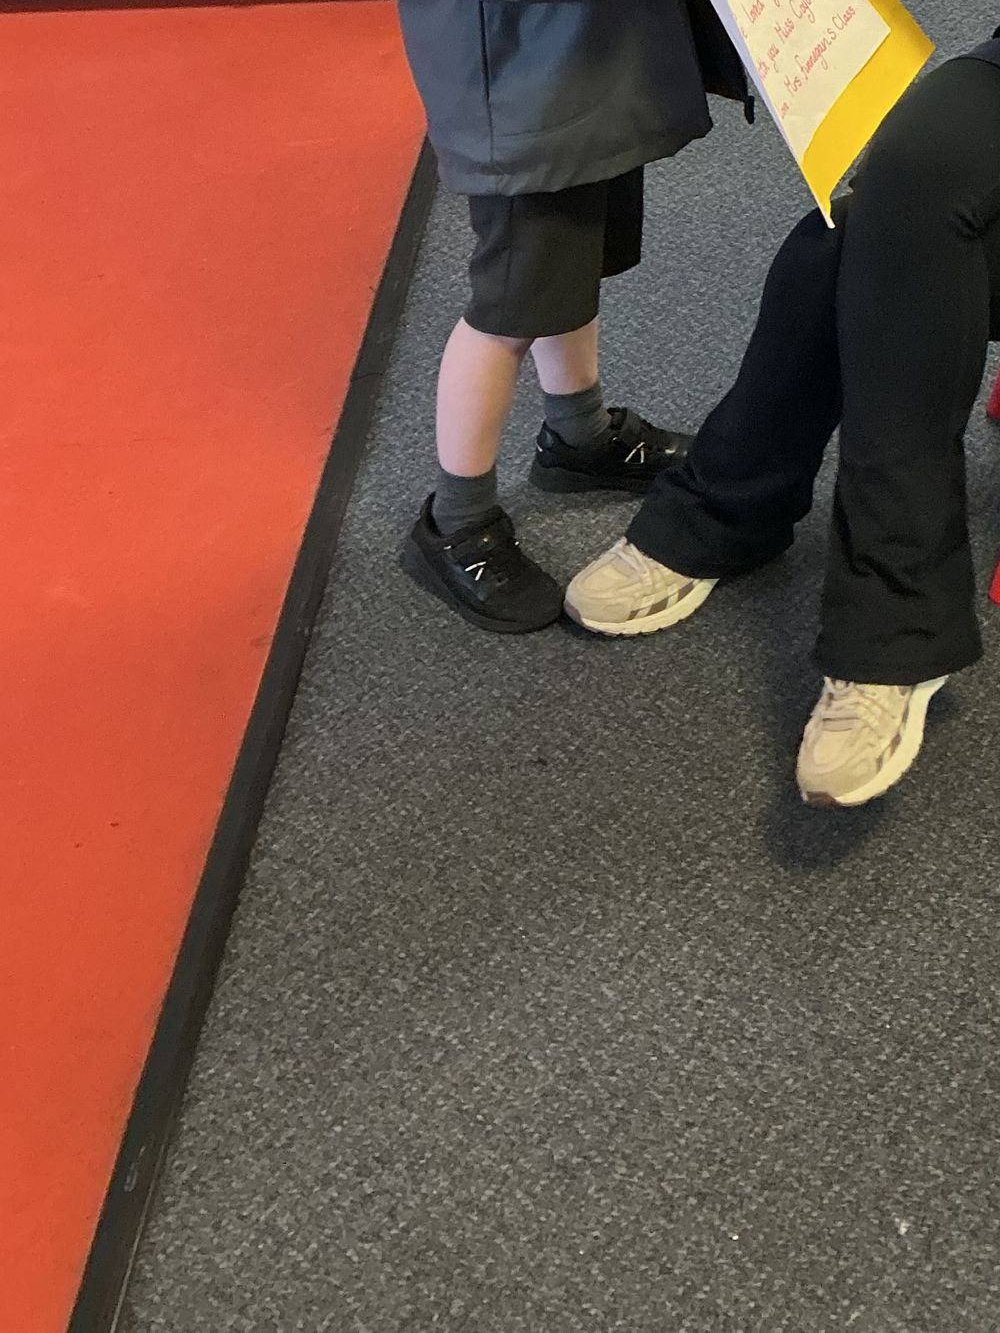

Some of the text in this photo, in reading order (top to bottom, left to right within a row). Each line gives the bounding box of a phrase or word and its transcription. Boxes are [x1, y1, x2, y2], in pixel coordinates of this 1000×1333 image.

[832, 6, 856, 31] Class
[768, 43, 780, 73] you
[774, 18, 795, 44] Miss
